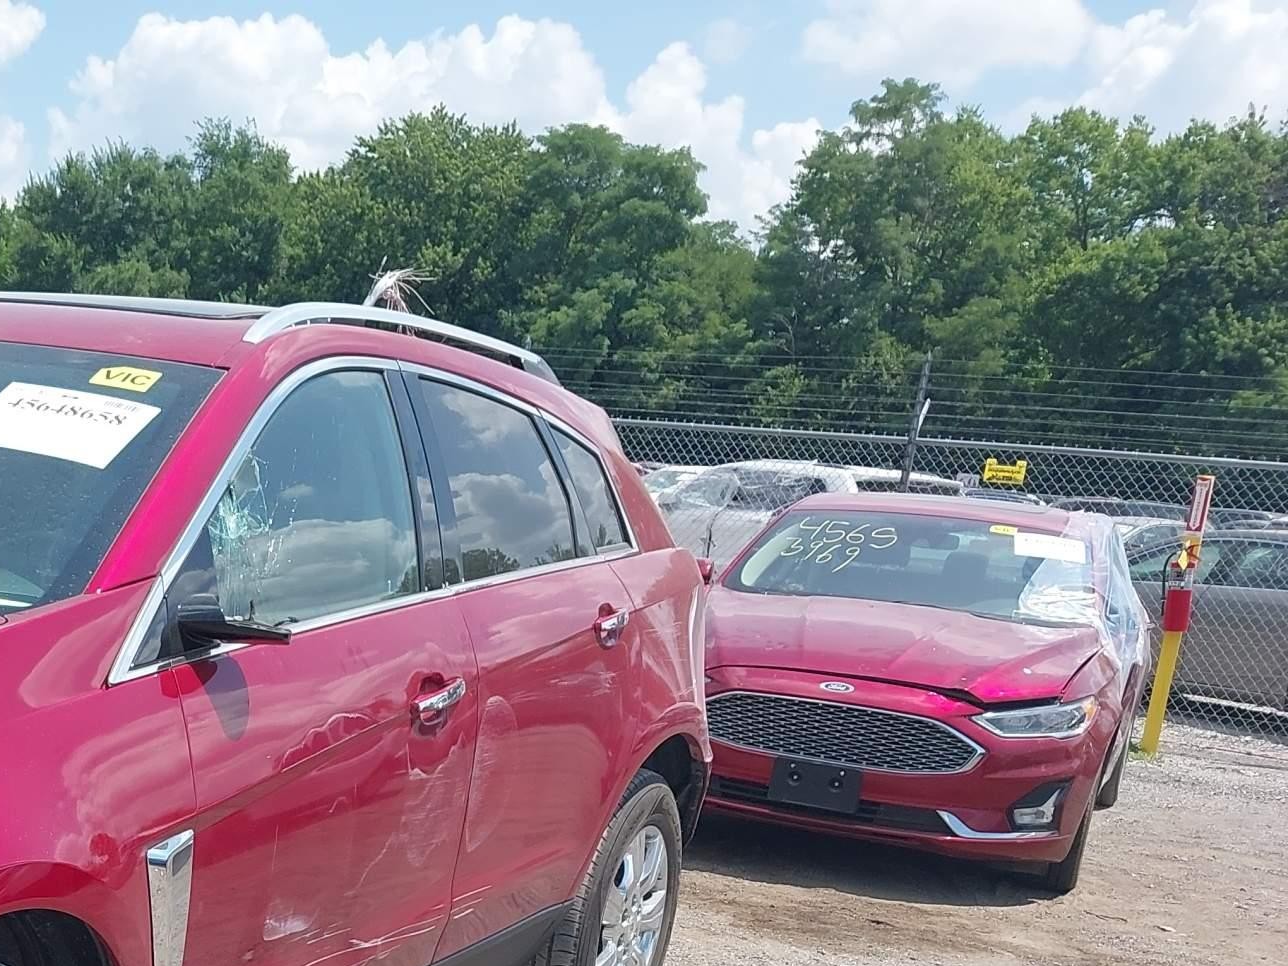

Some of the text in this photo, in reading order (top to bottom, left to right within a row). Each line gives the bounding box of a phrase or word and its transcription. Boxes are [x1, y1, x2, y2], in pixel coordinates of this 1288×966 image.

[105, 369, 152, 386] VIC
[8, 398, 127, 426] 45648658
[780, 537, 861, 573] 3969
